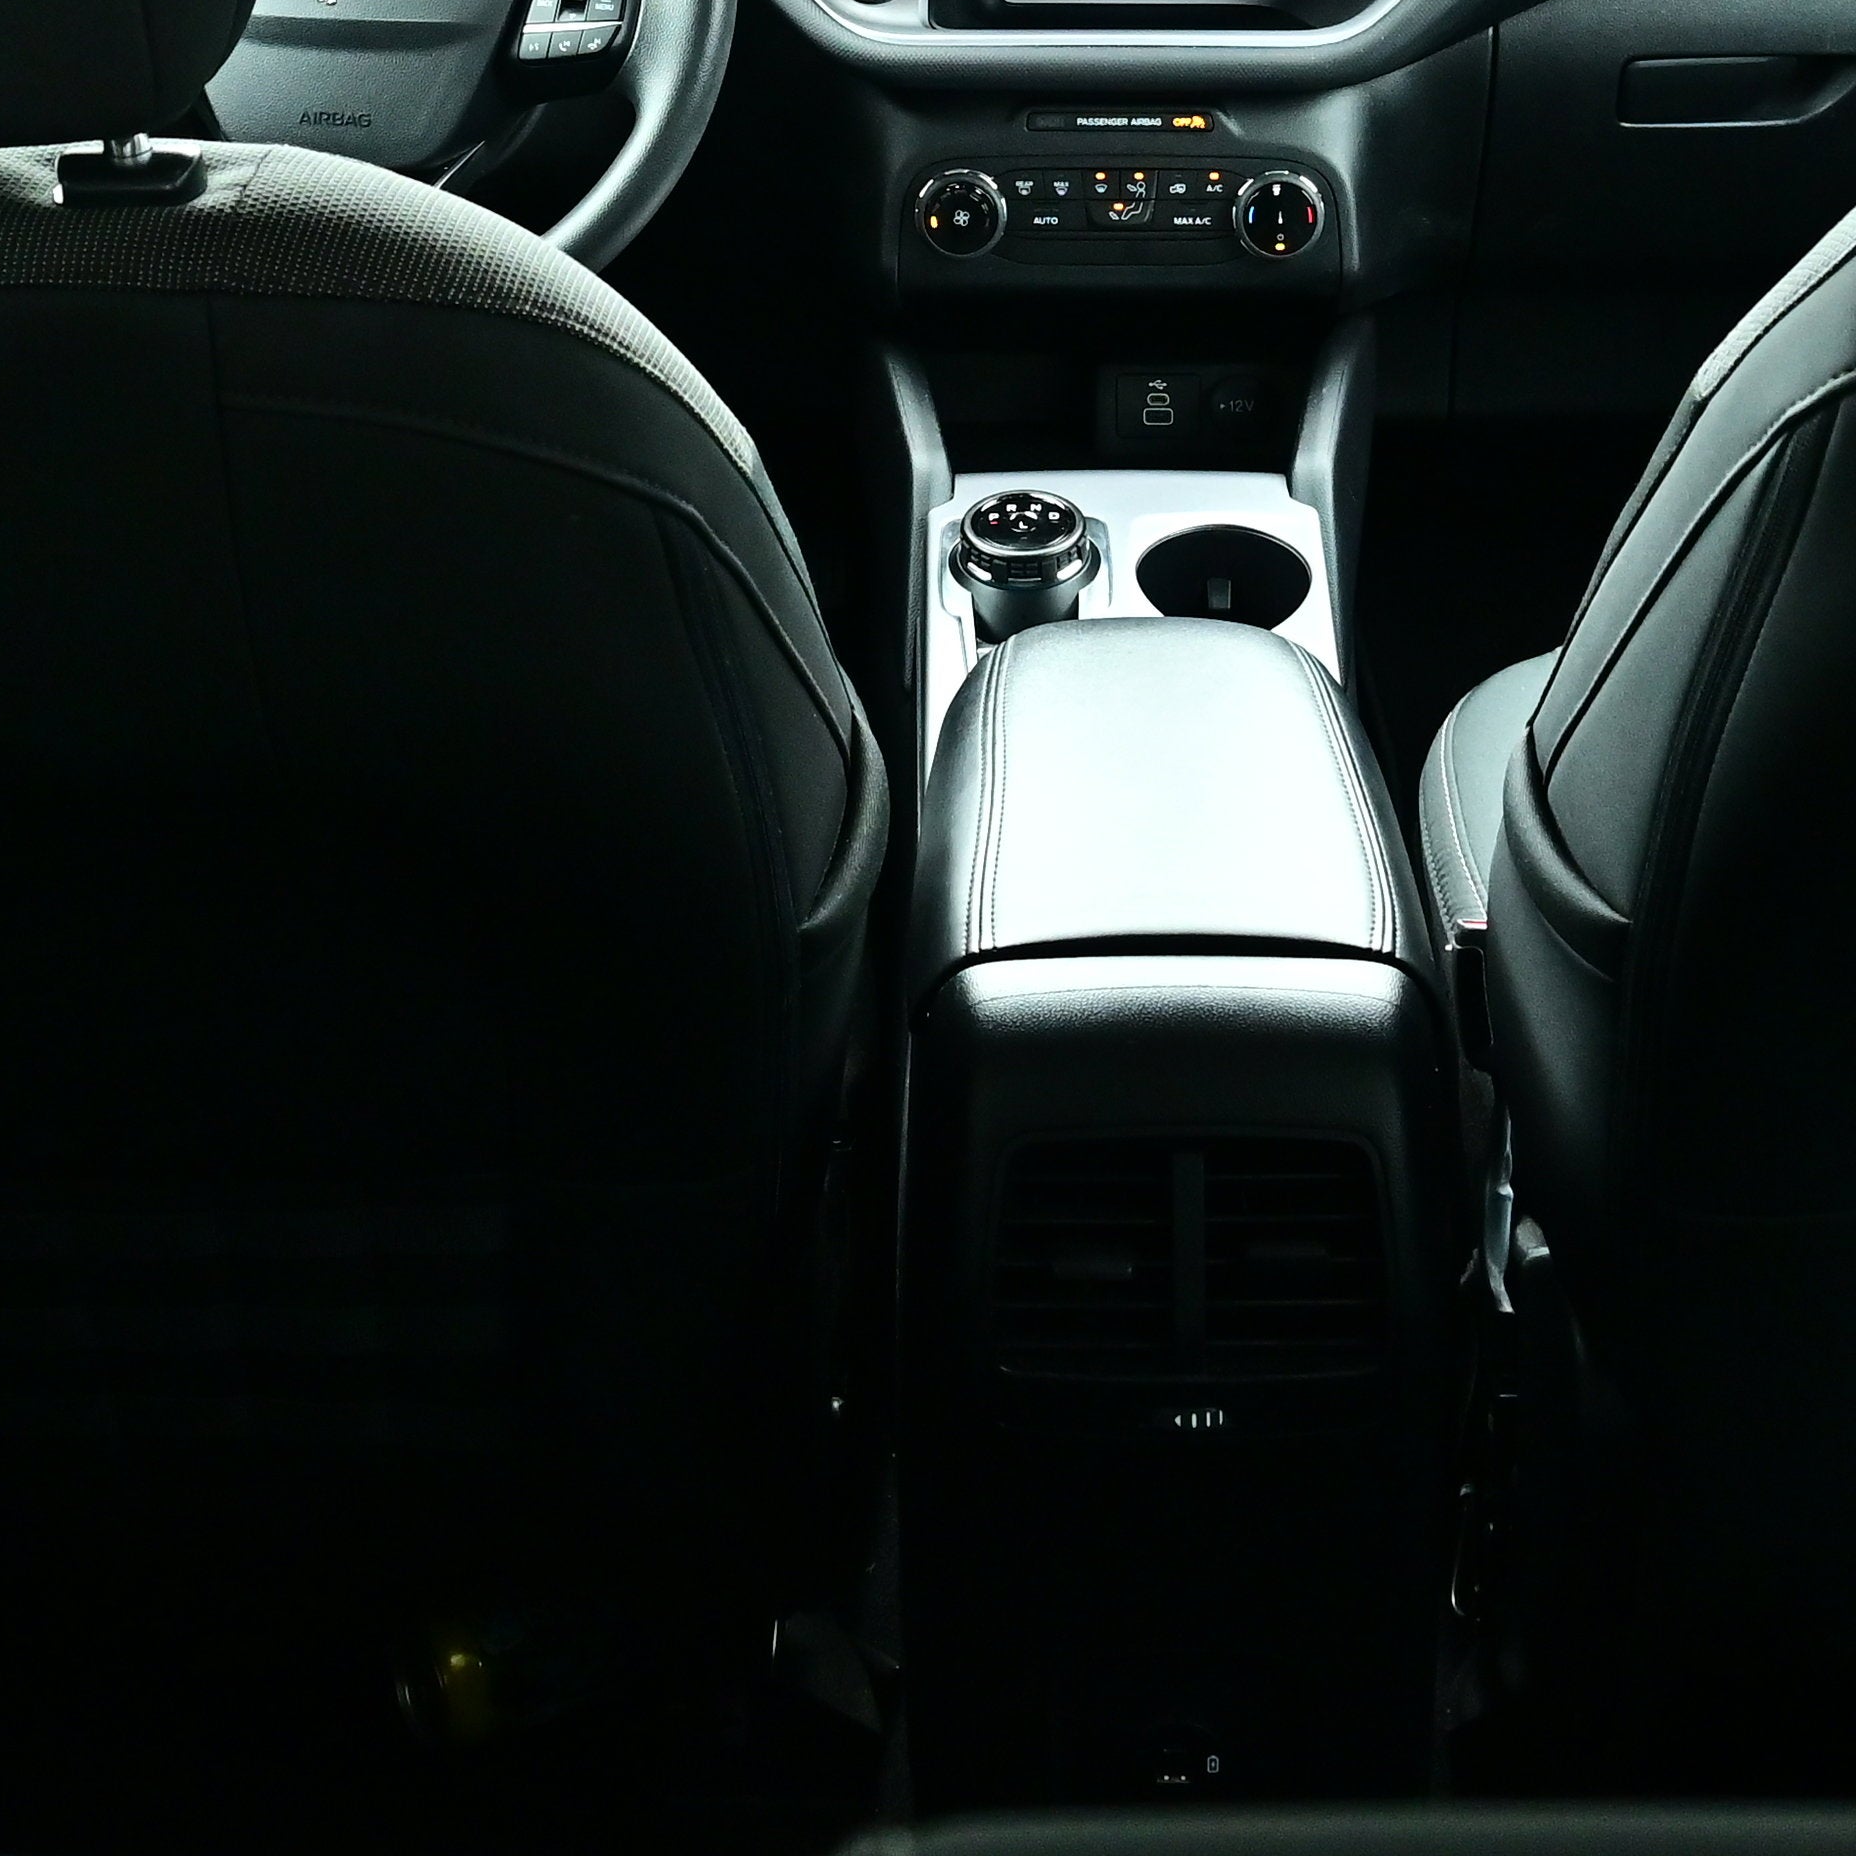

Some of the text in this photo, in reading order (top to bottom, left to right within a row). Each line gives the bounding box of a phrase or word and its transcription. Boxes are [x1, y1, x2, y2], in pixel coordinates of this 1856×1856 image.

[299, 111, 372, 128] AIRBAG
[1076, 117, 1192, 127] PASSENGER AIRBAG OFF
[1206, 184, 1224, 193] A/C
[1033, 216, 1059, 225] AUTO
[1173, 216, 1212, 225] MAX A/C
[1229, 400, 1254, 413] 12V
[1006, 504, 1017, 512] R
[1030, 504, 1042, 512] N
[988, 513, 1000, 522] P
[1048, 511, 1060, 520] D
[1018, 520, 1028, 529] L
